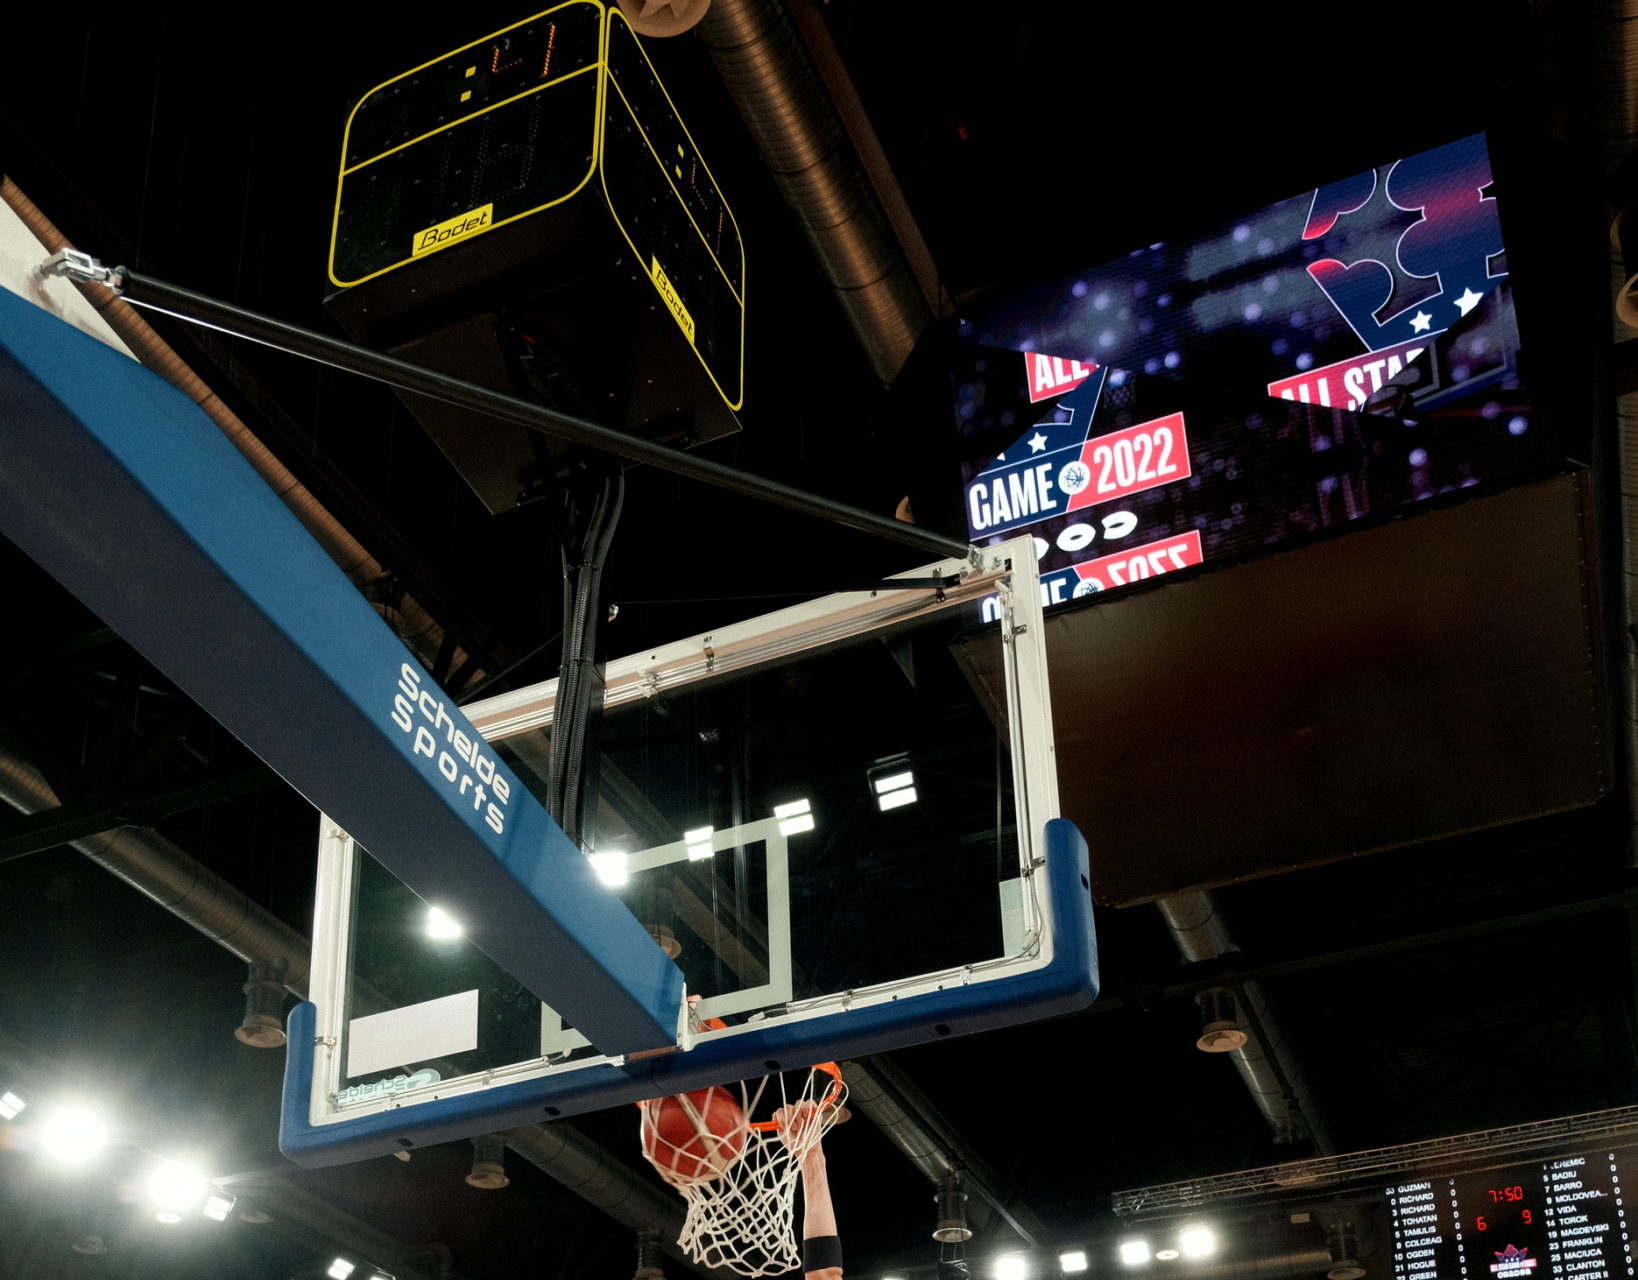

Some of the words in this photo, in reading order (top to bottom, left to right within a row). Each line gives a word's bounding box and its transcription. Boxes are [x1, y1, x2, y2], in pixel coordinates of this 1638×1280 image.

[417, 210, 488, 251] Bodet
[656, 269, 692, 337] Bodet
[968, 462, 1057, 531] GAME
[1093, 426, 1177, 494] 2022
[398, 662, 511, 806] Schelde
[391, 694, 505, 835] Sports
[1551, 1170, 1577, 1181] BADIU
[1610, 1164, 1617, 1172] 0
[1488, 1186, 1523, 1203] 7:50
[1544, 1186, 1550, 1194] 7
[1553, 1180, 1583, 1192] BARRO
[1614, 1187, 1620, 1195] 0
[1390, 1198, 1396, 1206] 0
[1398, 1192, 1434, 1204] RICHARD
[1450, 1188, 1456, 1196] 0
[1400, 1204, 1436, 1216] RICHARD
[1544, 1208, 1554, 1216] 12
[1556, 1204, 1577, 1215] VIDA
[1616, 1198, 1622, 1206] 0
[1402, 1214, 1438, 1226] TOHATAN
[1453, 1210, 1459, 1218] 0
[1476, 1216, 1487, 1231] 6
[1521, 1209, 1532, 1224] 9
[1546, 1220, 1556, 1228] 14
[1558, 1214, 1588, 1226] TOROK
[1618, 1209, 1624, 1218] 0
[1403, 1226, 1436, 1238] TAMULIS
[1454, 1222, 1460, 1230] 0
[1548, 1230, 1558, 1239] 19
[1560, 1223, 1610, 1238] MAGDEVSKI
[1620, 1220, 1626, 1229] 0
[1404, 1236, 1442, 1248] COLCEAG
[1562, 1236, 1604, 1249] FRANKLIN
[1622, 1232, 1628, 1240] 0
[1394, 1253, 1403, 1261] 10
[1406, 1248, 1435, 1260] OGDEN
[1458, 1244, 1464, 1252] 0
[1564, 1247, 1602, 1260] MACIUCA
[1624, 1244, 1630, 1252] 0
[1394, 1264, 1404, 1272] 21
[1407, 1260, 1436, 1270] HOGUE
[1461, 1266, 1467, 1274] 0
[1552, 1265, 1563, 1274] 33
[1566, 1259, 1606, 1272] CLANTON
[1626, 1256, 1632, 1264] 0
[1628, 1267, 1634, 1276] 0
